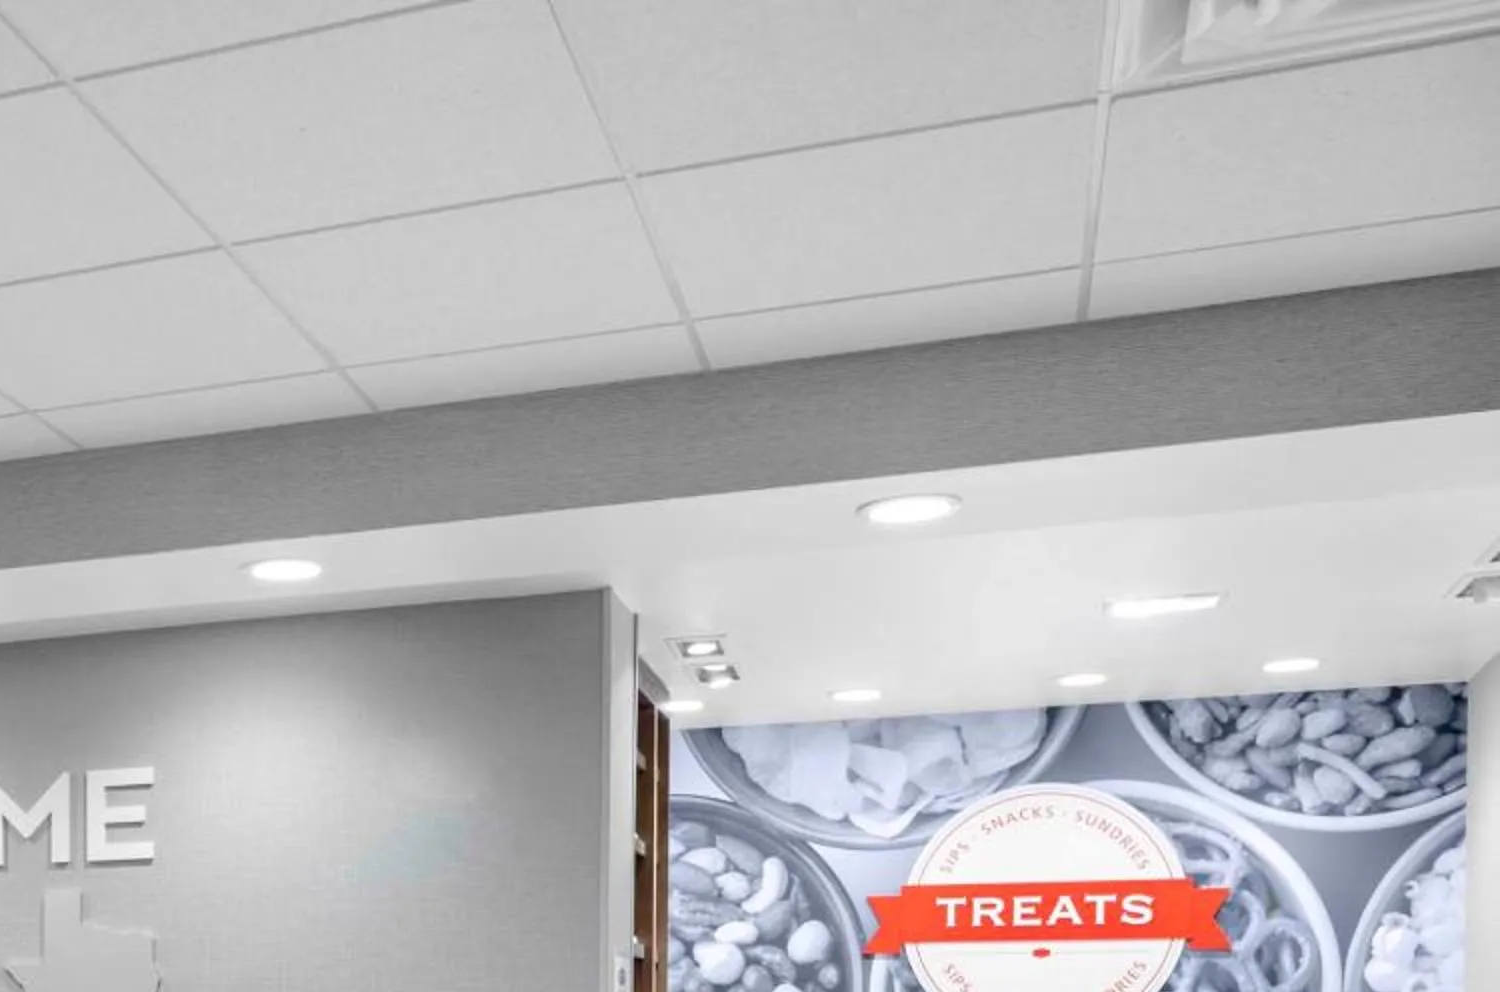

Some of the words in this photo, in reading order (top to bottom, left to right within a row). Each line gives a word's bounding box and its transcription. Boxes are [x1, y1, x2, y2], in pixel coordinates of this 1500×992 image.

[939, 839, 970, 874] SIPS
[979, 806, 1056, 835] SNACKS
[1075, 810, 1151, 872] SUNDRIES
[935, 893, 1155, 928] TREATS
